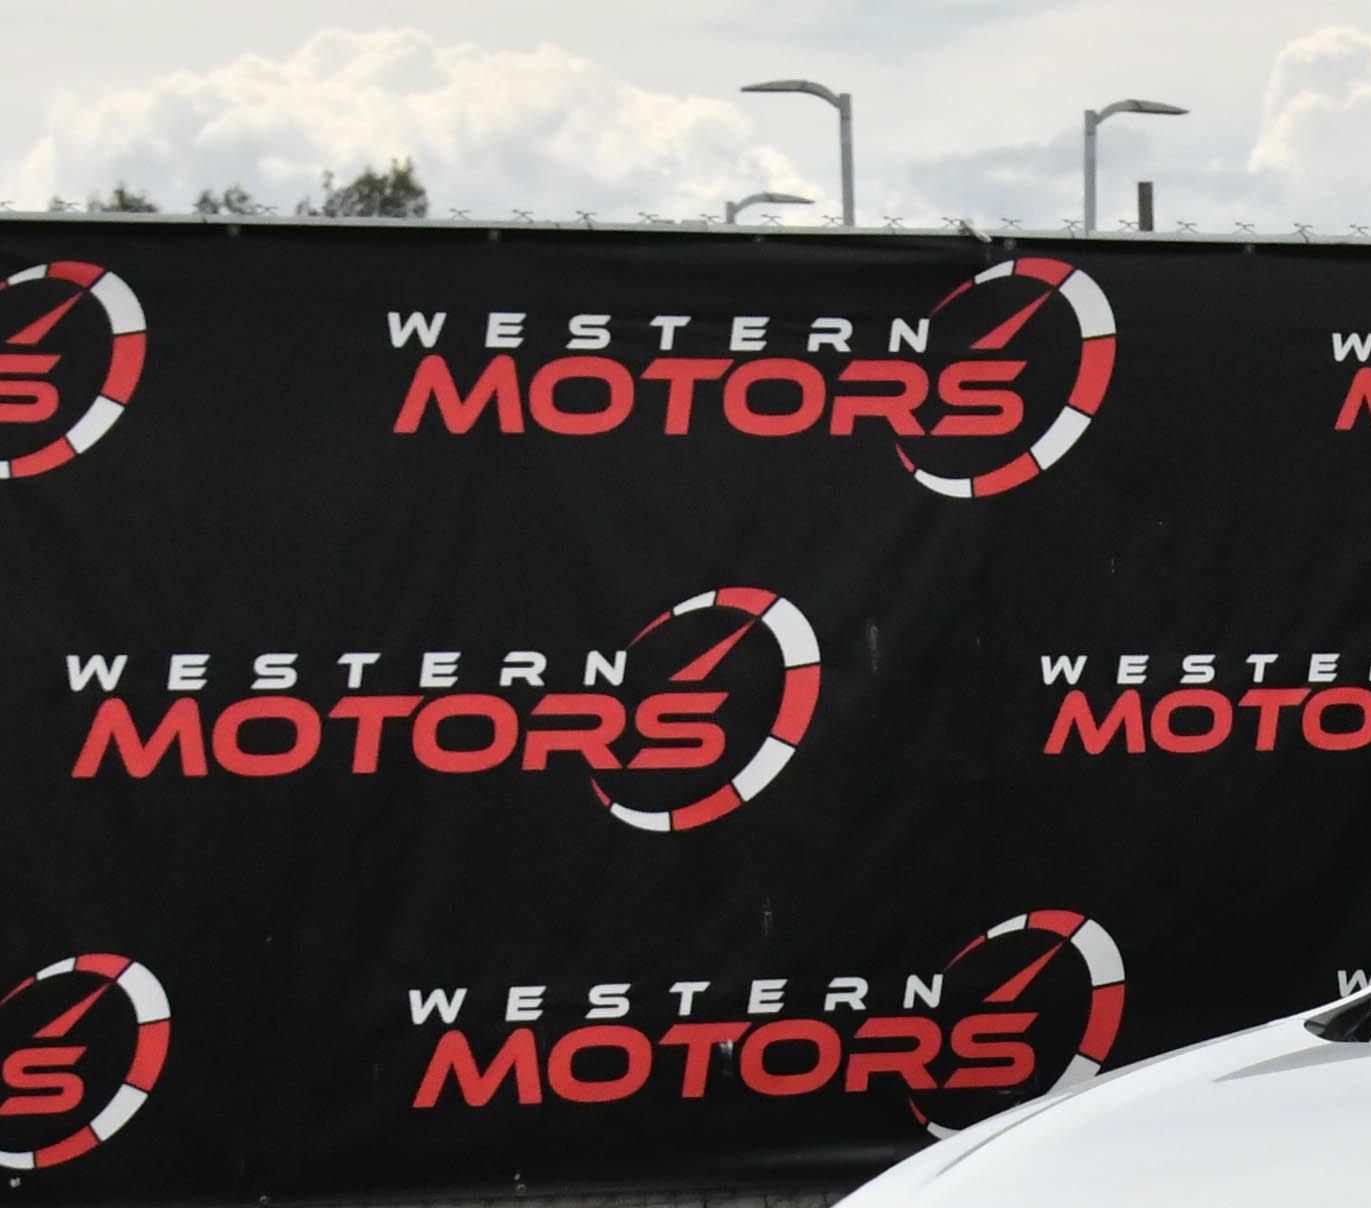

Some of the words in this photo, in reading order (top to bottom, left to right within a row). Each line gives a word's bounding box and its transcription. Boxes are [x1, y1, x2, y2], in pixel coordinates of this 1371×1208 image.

[387, 311, 930, 353] WESTERN
[393, 354, 1028, 437] MOTORS
[66, 650, 627, 692] WESTERN
[71, 691, 729, 779] MOTORS
[408, 974, 943, 1025] WESTERN
[413, 1012, 1038, 1108] MOTORS
